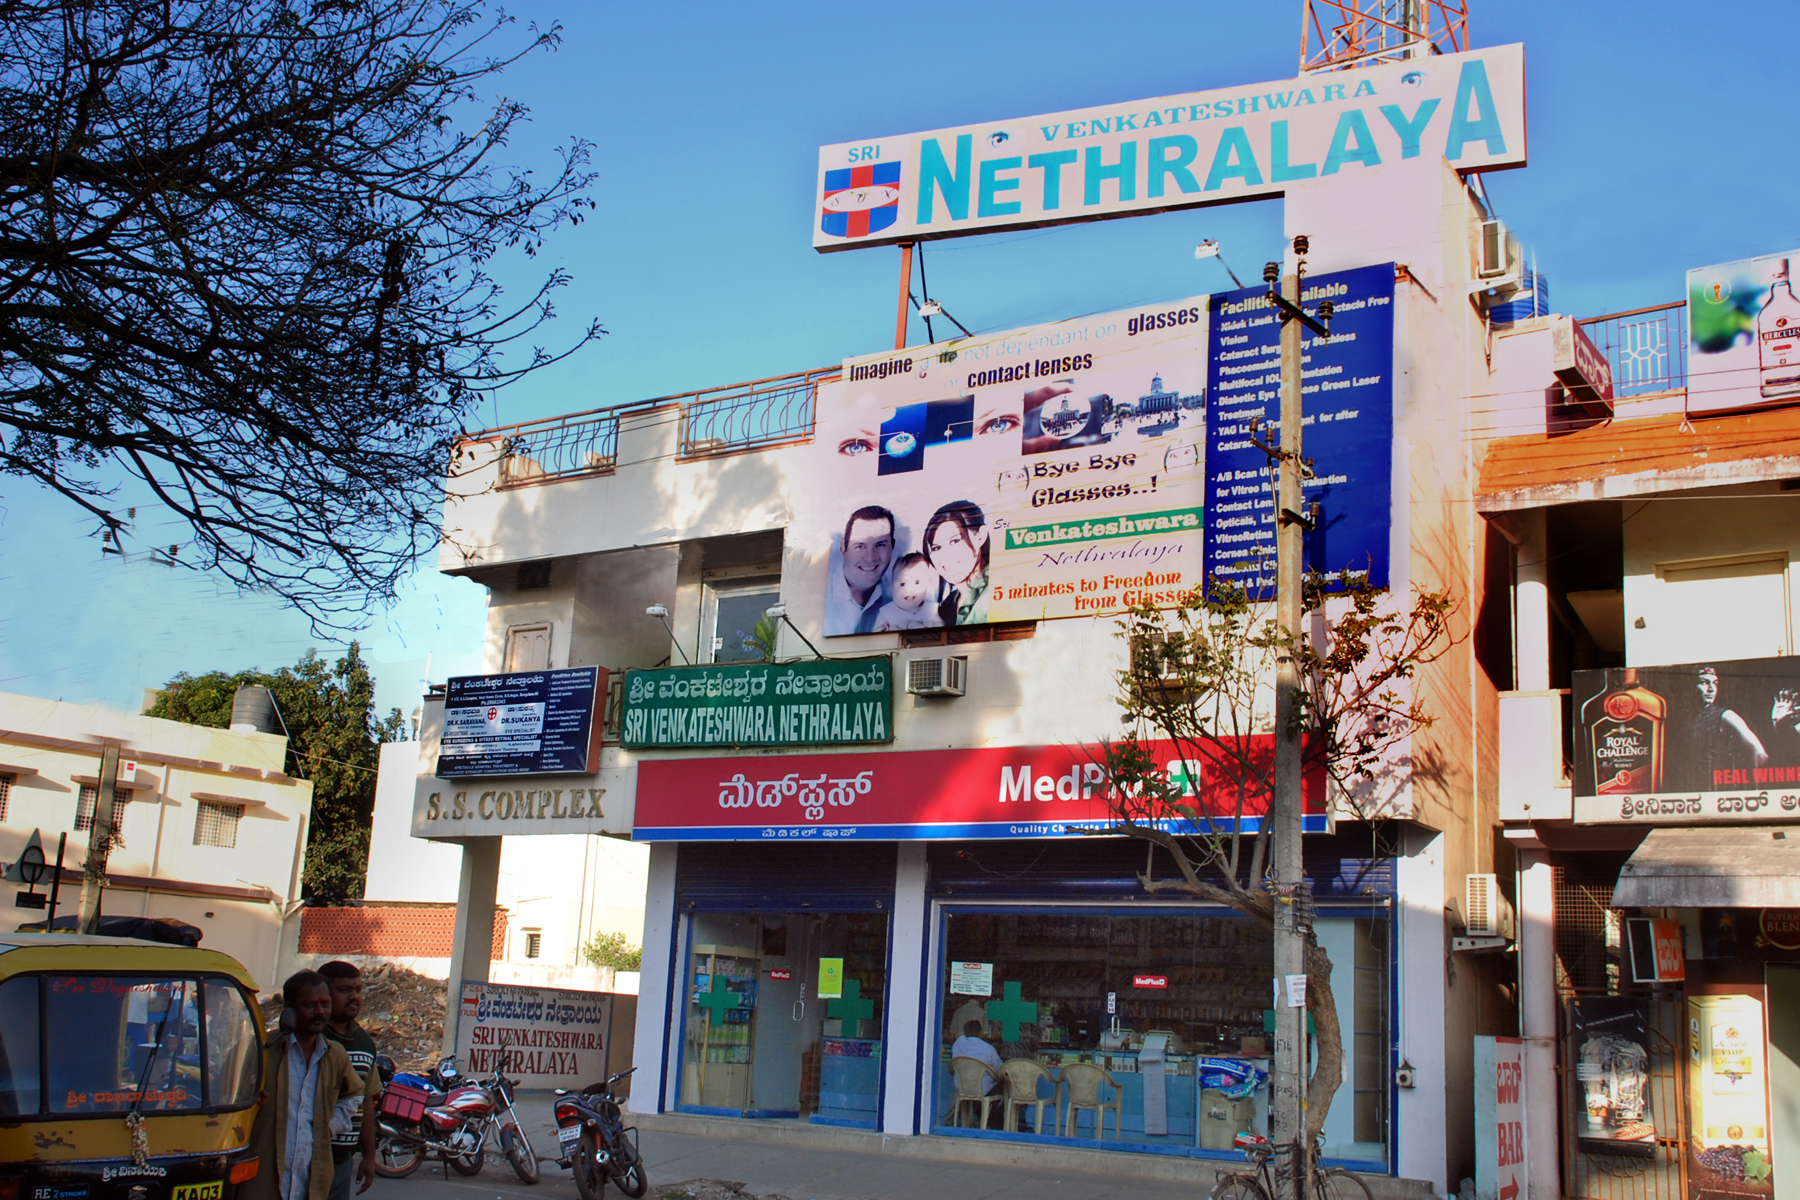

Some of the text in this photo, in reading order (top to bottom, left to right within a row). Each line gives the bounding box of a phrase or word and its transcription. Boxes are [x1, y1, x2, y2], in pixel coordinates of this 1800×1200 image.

[1040, 78, 1378, 142] VENKATESHWARA
[916, 60, 1508, 225] NETHRALAYA
[847, 144, 881, 163] SRI
[1367, 296, 1390, 307] Free
[849, 355, 914, 382] Imagine
[964, 343, 991, 363] not
[995, 326, 1089, 357] dependant
[1095, 323, 1118, 340] on
[1127, 306, 1200, 336] glasses
[1220, 335, 1249, 347] Vision
[1220, 347, 1260, 362] Cataract
[967, 361, 1031, 389] contact
[1034, 353, 1094, 378] lenses
[1218, 375, 1264, 391] Multifocal
[1218, 375, 1381, 407] Diabetic Eye Green Laser
[1218, 405, 1266, 422] Treatment
[1218, 408, 1360, 436] YAG for after
[1033, 452, 1138, 479] Bye Bye
[1216, 473, 1233, 483] A/B
[1234, 470, 1258, 480] Scan
[1216, 488, 1230, 498] for
[1216, 500, 1253, 514] Contact
[993, 518, 1011, 530] Sri
[1009, 512, 1200, 546] Venkateshwara
[1037, 540, 1184, 568] Nethralaya
[1215, 548, 1249, 560] Cornea
[993, 571, 1182, 601] 5 minutes to Freedom
[1074, 594, 1117, 611] from
[629, 663, 886, 705] ಶ್ರೀ ವೆಂಕಟೇಶ್ವರ ನೇತ್ರಾಲಯ
[624, 708, 648, 743] SRI
[650, 704, 776, 743] VENKATESHWARA
[779, 701, 886, 743] NETHRALAYA
[1606, 736, 1640, 749] ROYAL
[1597, 747, 1650, 758] CHALLENGE
[1713, 768, 1750, 785] REAL
[1620, 794, 1702, 819] ಶ್ರೀನಿವಾಸ
[1717, 791, 1769, 814] ಬಾರ್
[1010, 825, 1049, 835] Quality
[472, 1026, 603, 1050] SRI VENKATESHWARA
[1721, 1048, 1745, 1056] VSOP
[1497, 1121, 1524, 1167] BAR
[102, 1166, 117, 1182] ಶ್ರೀ
[34, 1188, 88, 1200] RE 2 STROKE
